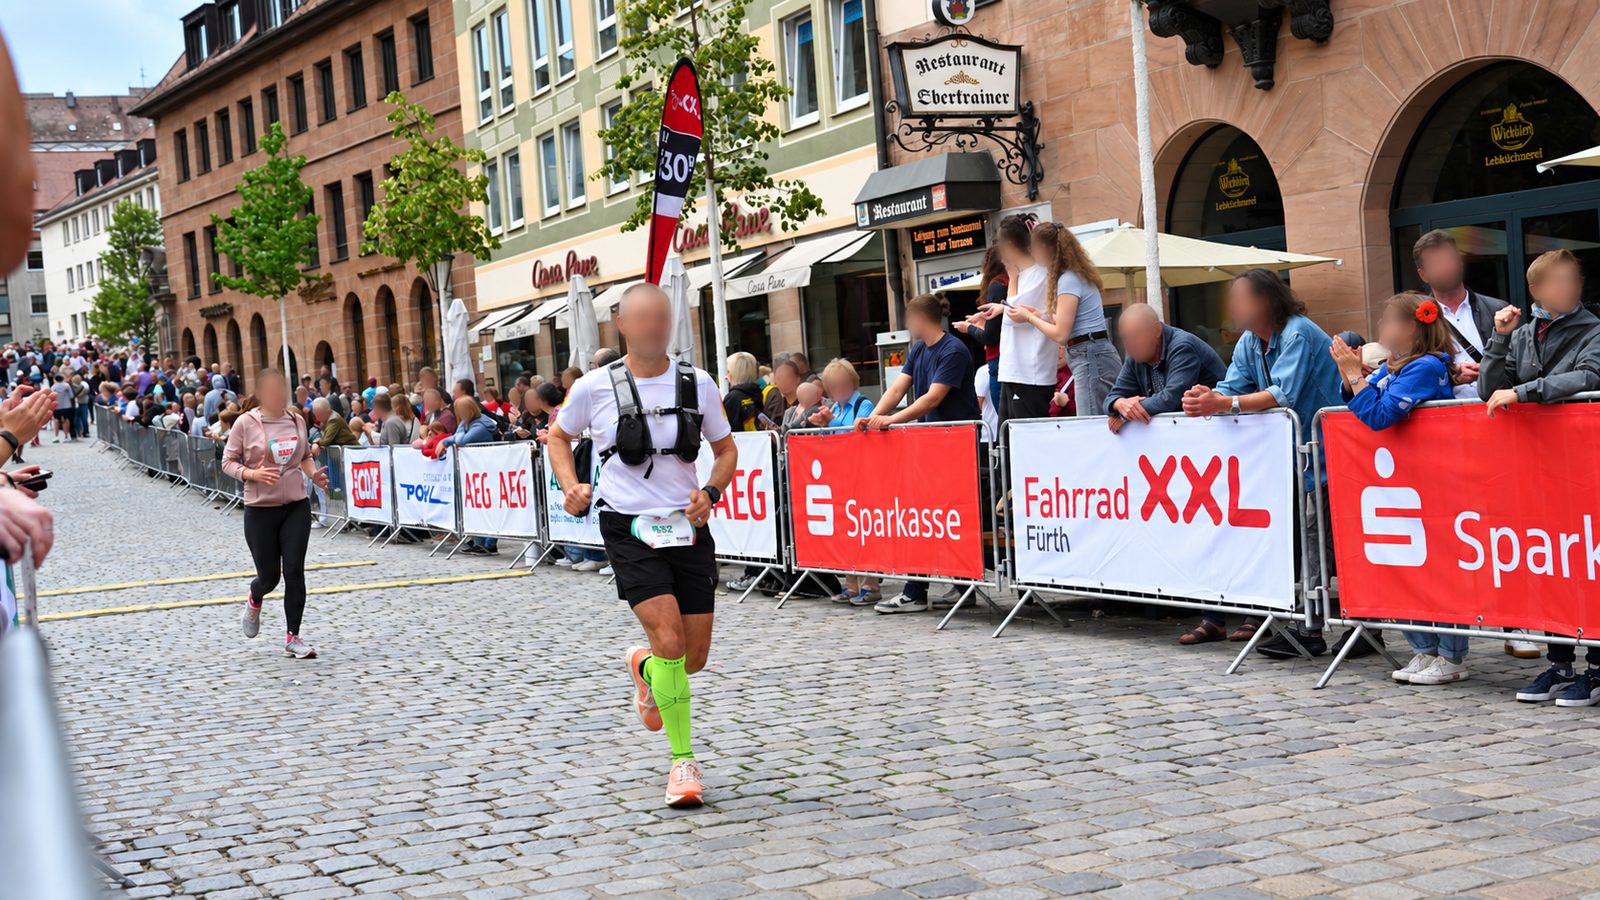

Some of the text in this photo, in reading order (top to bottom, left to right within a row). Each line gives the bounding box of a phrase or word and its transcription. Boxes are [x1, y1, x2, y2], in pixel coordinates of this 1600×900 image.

[915, 52, 1006, 76] Restaurant
[873, 195, 927, 220] Restaurant
[532, 259, 564, 289] Casa
[747, 275, 786, 295] Casa Pane
[465, 472, 492, 509] AEG
[499, 469, 527, 508] AEG
[1024, 454, 1271, 529] Fahrrad XXL
[845, 496, 961, 546] Sparkasse
[1026, 524, 1071, 553] Fürth
